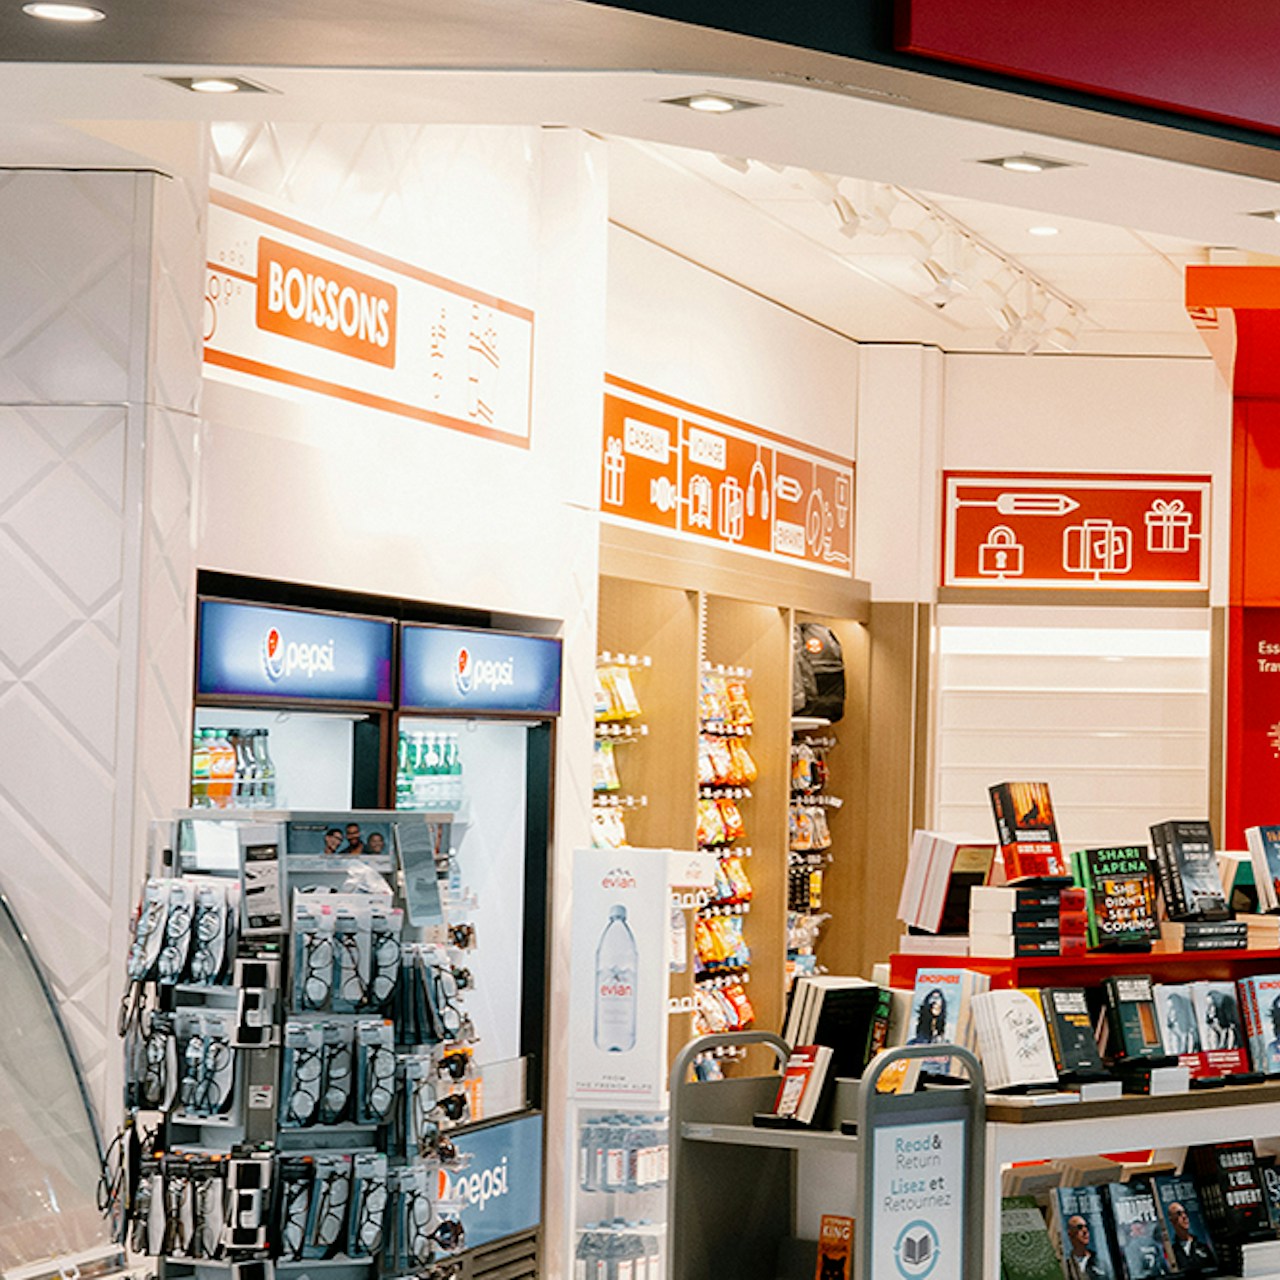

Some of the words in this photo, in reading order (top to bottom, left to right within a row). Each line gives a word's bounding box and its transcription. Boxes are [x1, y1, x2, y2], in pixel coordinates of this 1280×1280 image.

[267, 260, 390, 349] BOISSONS
[286, 639, 336, 677] pepsi
[472, 657, 515, 691] pepsi
[1097, 848, 1139, 863] SHARI
[1093, 861, 1147, 875] LAPENA
[601, 876, 636, 888] evian
[1114, 883, 1137, 895] SHE
[1108, 908, 1130, 920] SEE
[1103, 919, 1154, 933] COMING
[600, 984, 633, 997] evian
[896, 1154, 941, 1169] Return
[891, 1179, 926, 1195] Lisez
[929, 1177, 945, 1190] et
[883, 1195, 951, 1212] Retournez
[822, 1225, 850, 1240] KING
